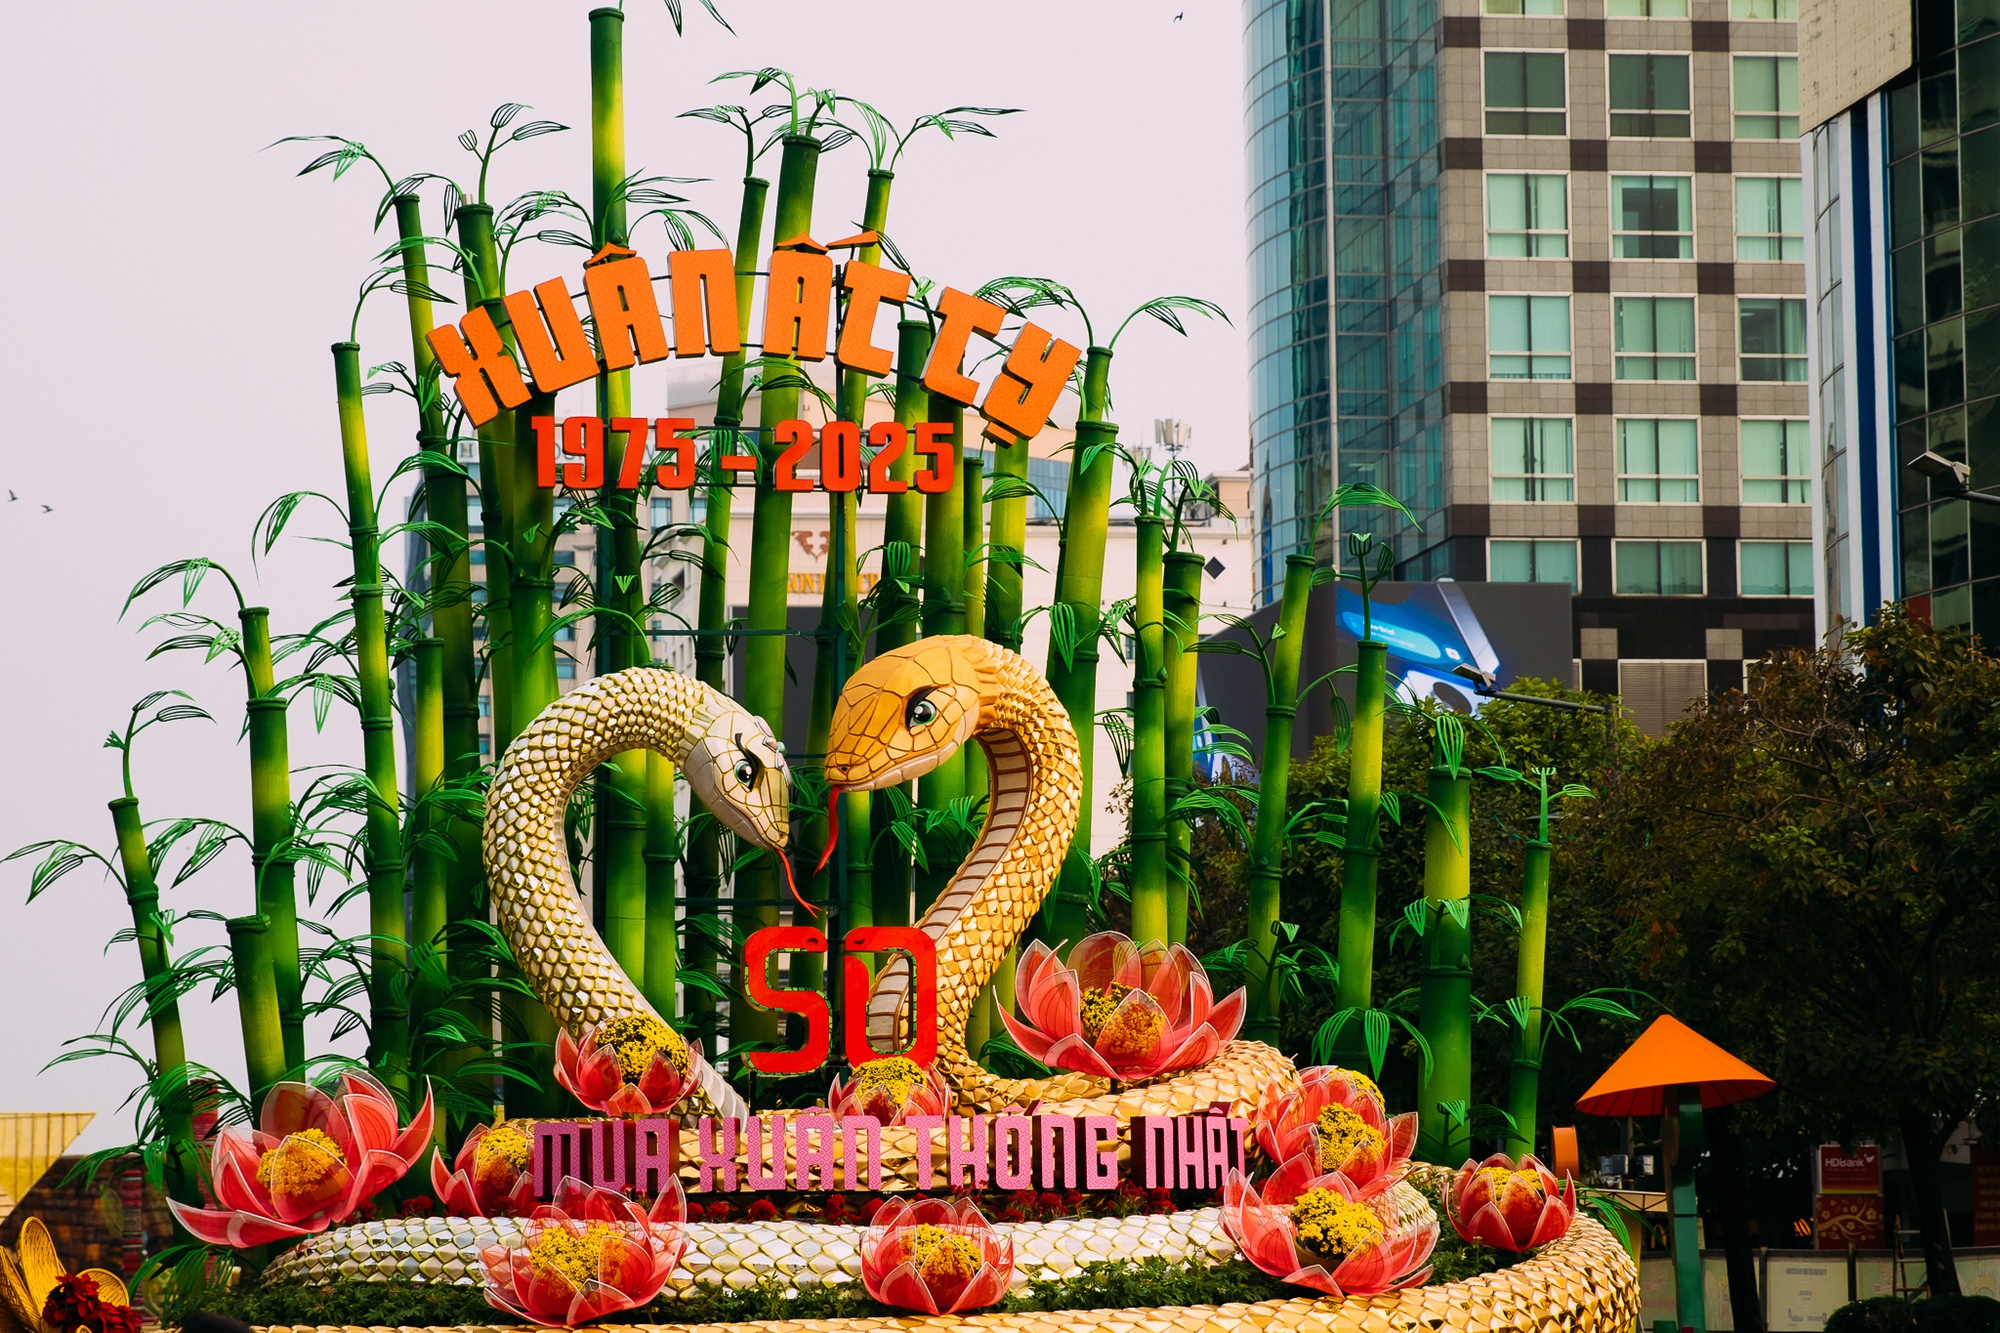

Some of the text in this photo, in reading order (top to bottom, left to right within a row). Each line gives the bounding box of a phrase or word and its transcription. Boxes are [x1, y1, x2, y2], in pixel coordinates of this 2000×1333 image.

[425, 241, 741, 429] XUÂN
[759, 229, 913, 380] ẤT
[530, 415, 698, 491] 1975
[774, 418, 956, 494] 2025
[533, 1099, 1249, 1197] MÙA XUÂN THỐNG NHẤT
[1824, 1157, 1865, 1168] HDBank
